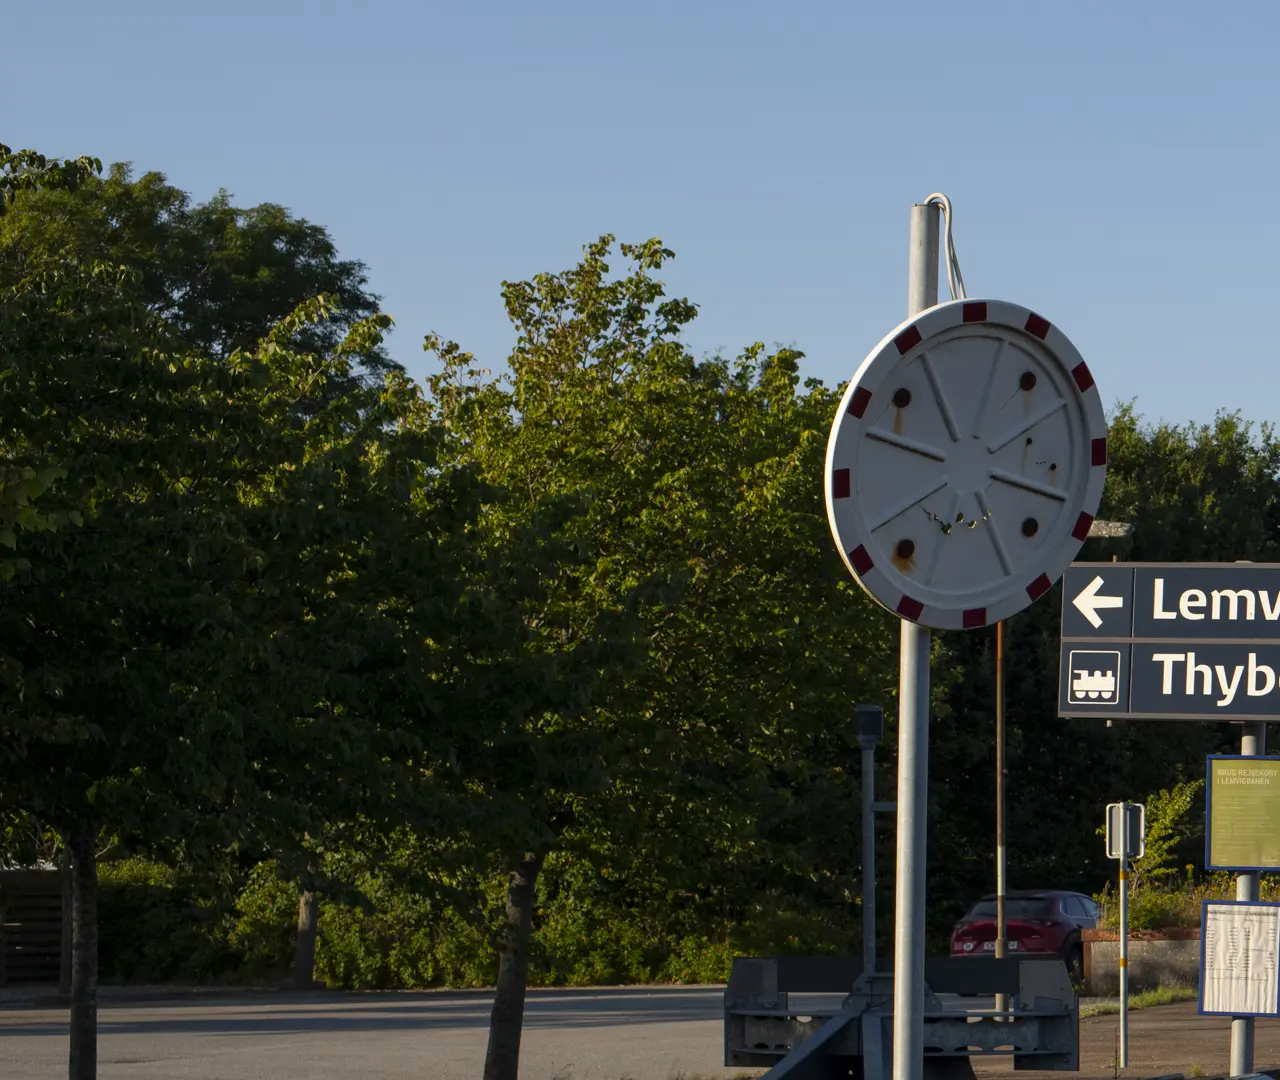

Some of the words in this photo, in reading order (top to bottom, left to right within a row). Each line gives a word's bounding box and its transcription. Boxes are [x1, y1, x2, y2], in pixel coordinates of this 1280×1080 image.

[1217, 768, 1237, 776] BRUG
[1237, 769, 1278, 777] REJSEKORT
[1221, 777, 1270, 785] LEMVIGBANEN
